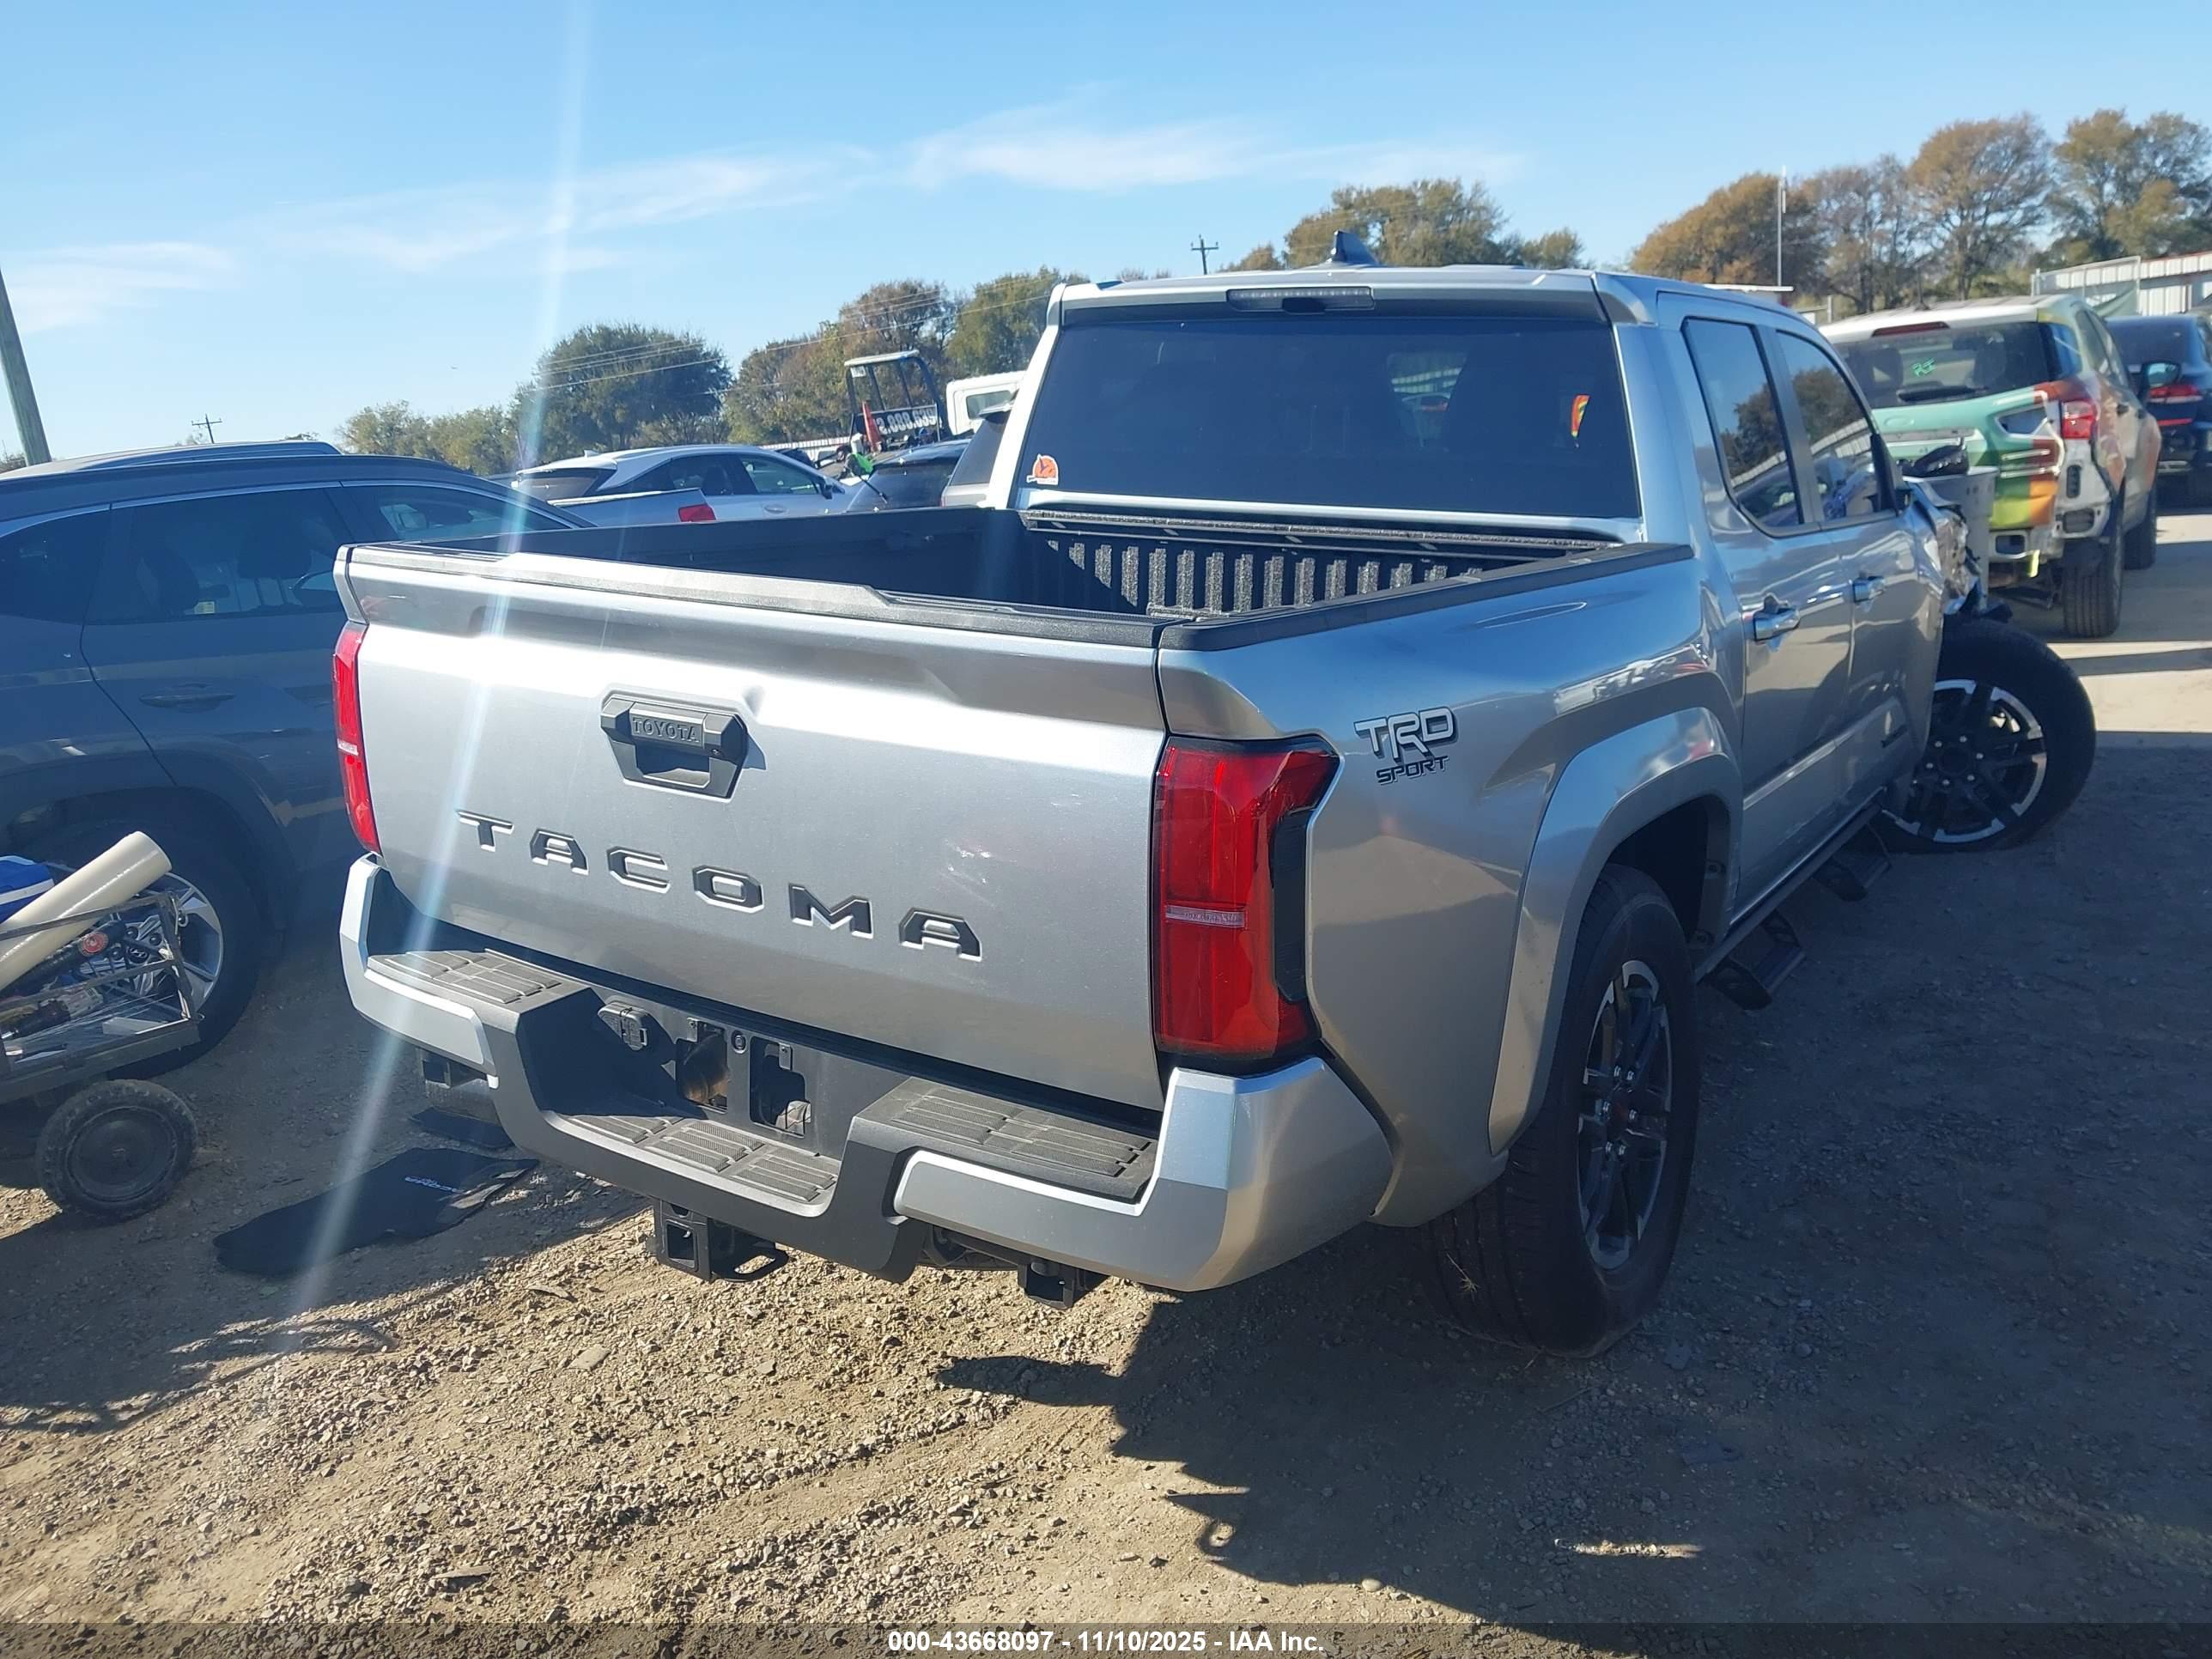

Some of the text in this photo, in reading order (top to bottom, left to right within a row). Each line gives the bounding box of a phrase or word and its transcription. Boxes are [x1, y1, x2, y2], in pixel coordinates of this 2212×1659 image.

[632, 716, 700, 743] TOYOTA
[1353, 706, 1457, 761] TRD
[1376, 756, 1450, 785] SPORT
[456, 811, 982, 962] TACOMA
